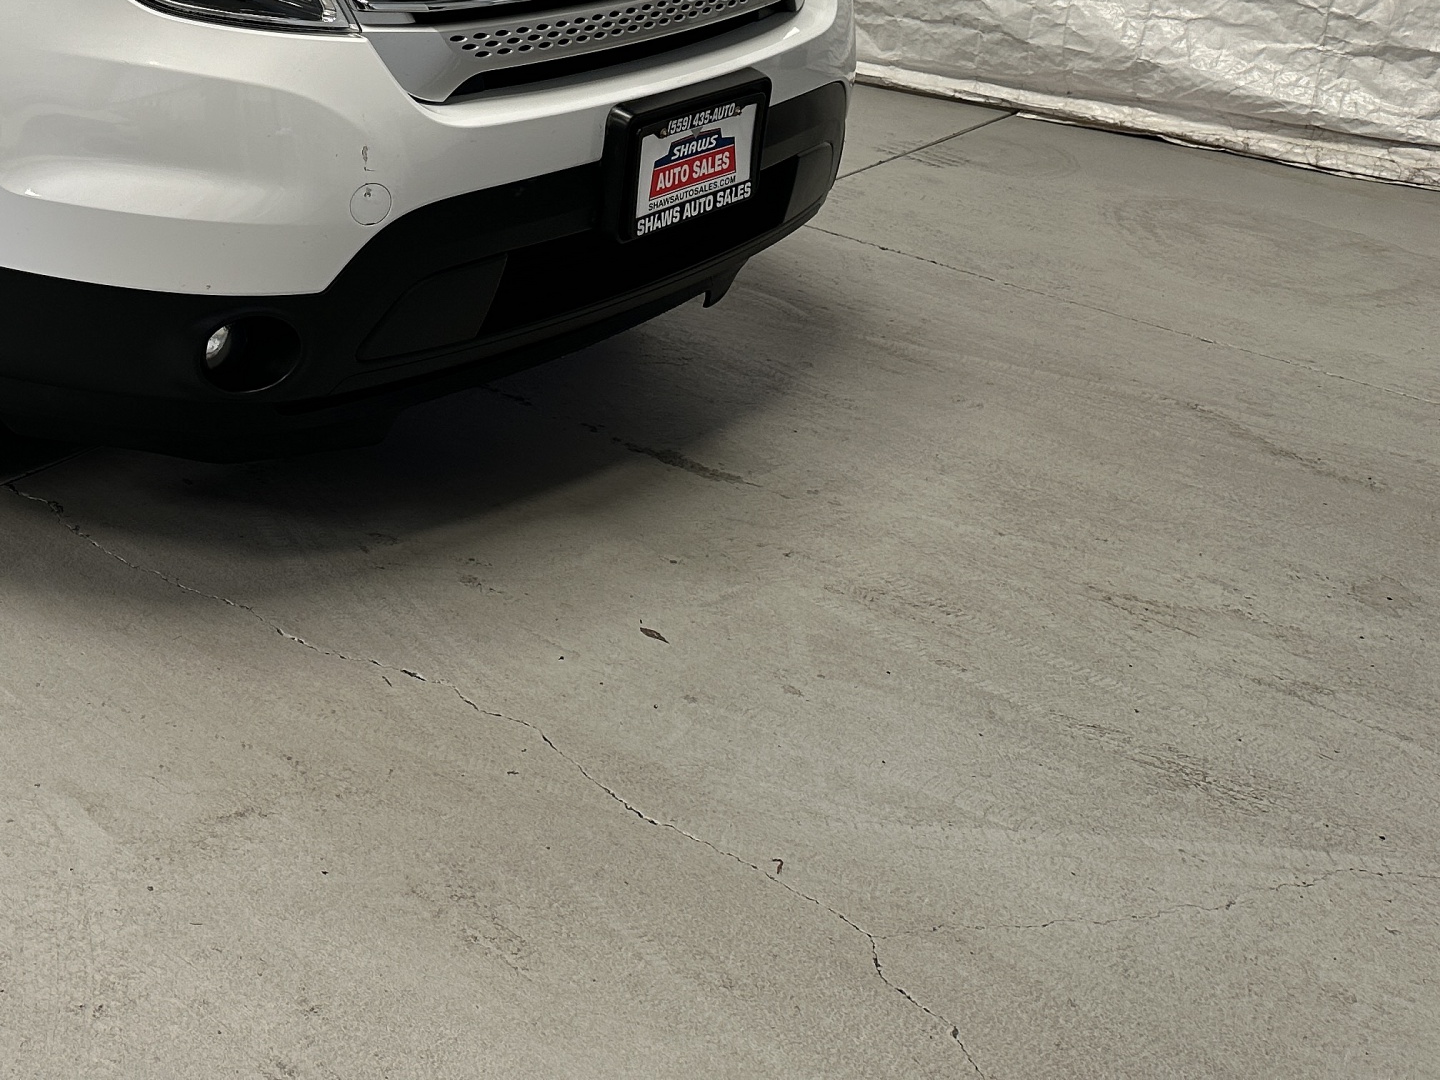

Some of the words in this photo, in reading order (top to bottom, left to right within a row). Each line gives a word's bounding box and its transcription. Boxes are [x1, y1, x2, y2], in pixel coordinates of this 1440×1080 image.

[667, 115, 692, 136] (559)
[692, 103, 735, 126] 435-AUTO
[670, 134, 719, 160] SHAWS
[656, 164, 690, 192] AUTO
[692, 151, 730, 179] SALES
[636, 205, 681, 237] SHAWS
[682, 194, 714, 220] AUTO
[716, 181, 752, 208] SALES
[647, 175, 736, 212] SHAWSAUTOSALES.COM
